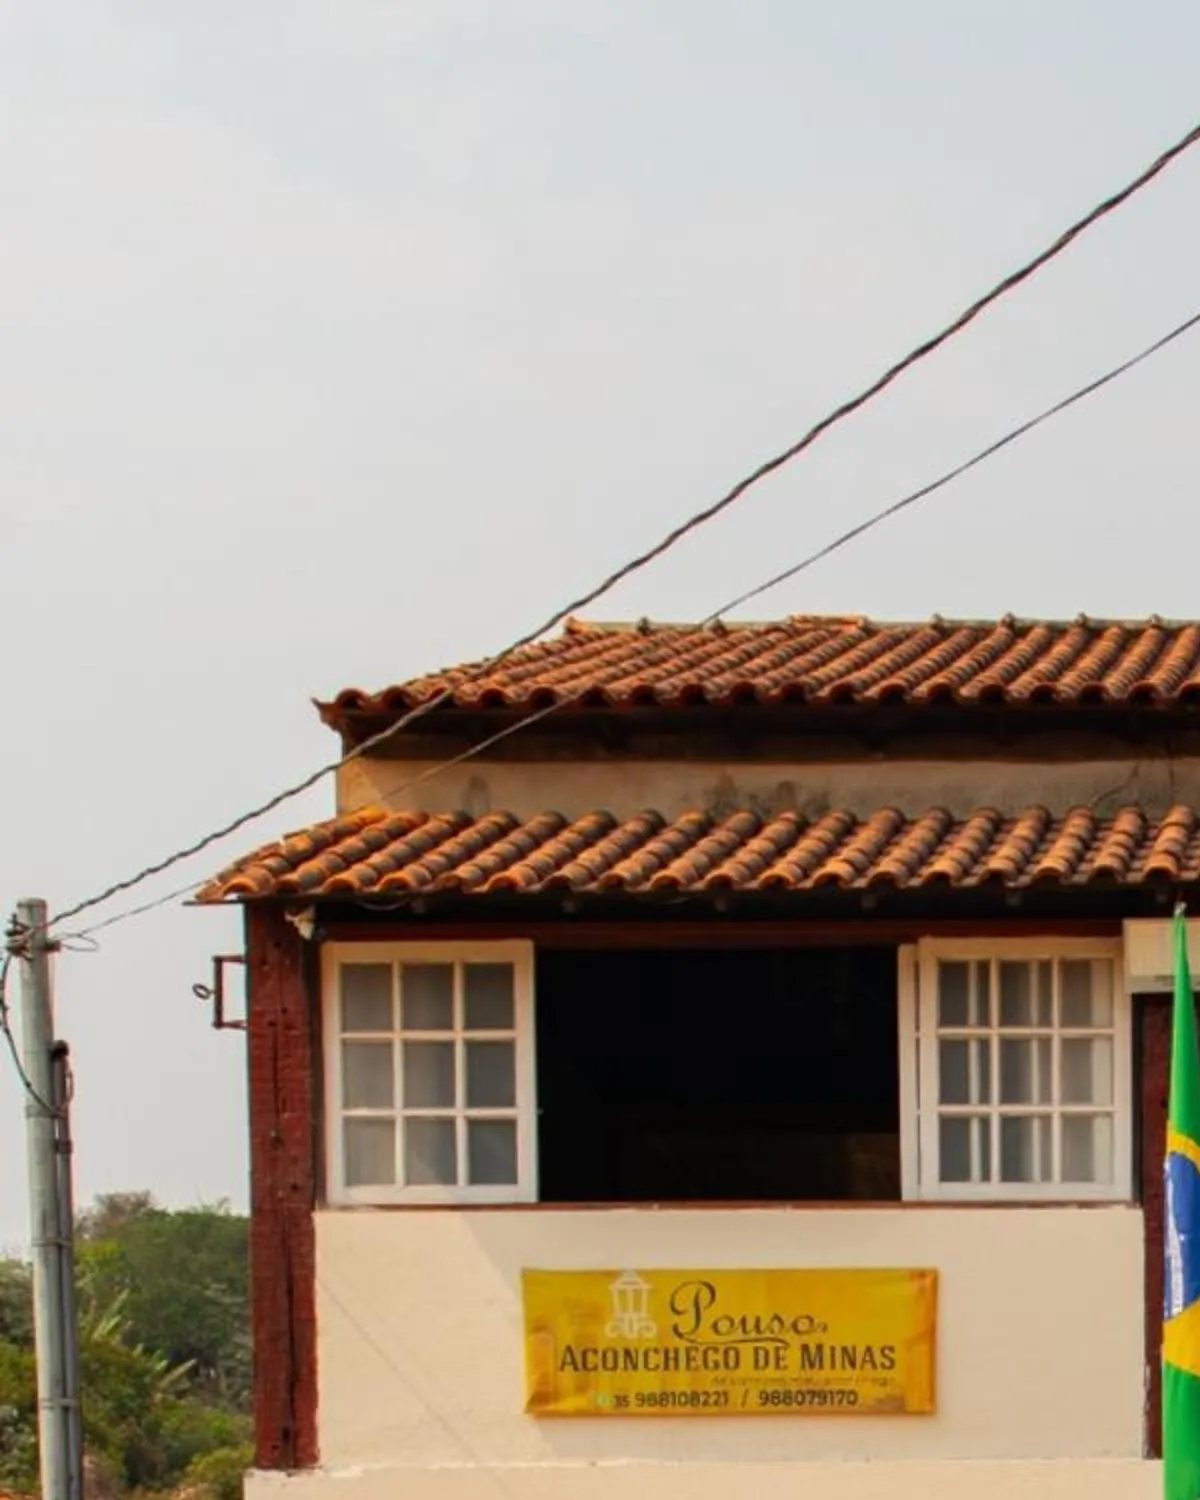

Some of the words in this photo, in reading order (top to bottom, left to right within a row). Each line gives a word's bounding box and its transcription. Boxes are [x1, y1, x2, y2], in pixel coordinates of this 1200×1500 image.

[670, 1280, 828, 1346] Pouso
[559, 1344, 741, 1372] ACONCHEGO
[753, 1346, 790, 1370] DE
[801, 1343, 897, 1371] MINAS
